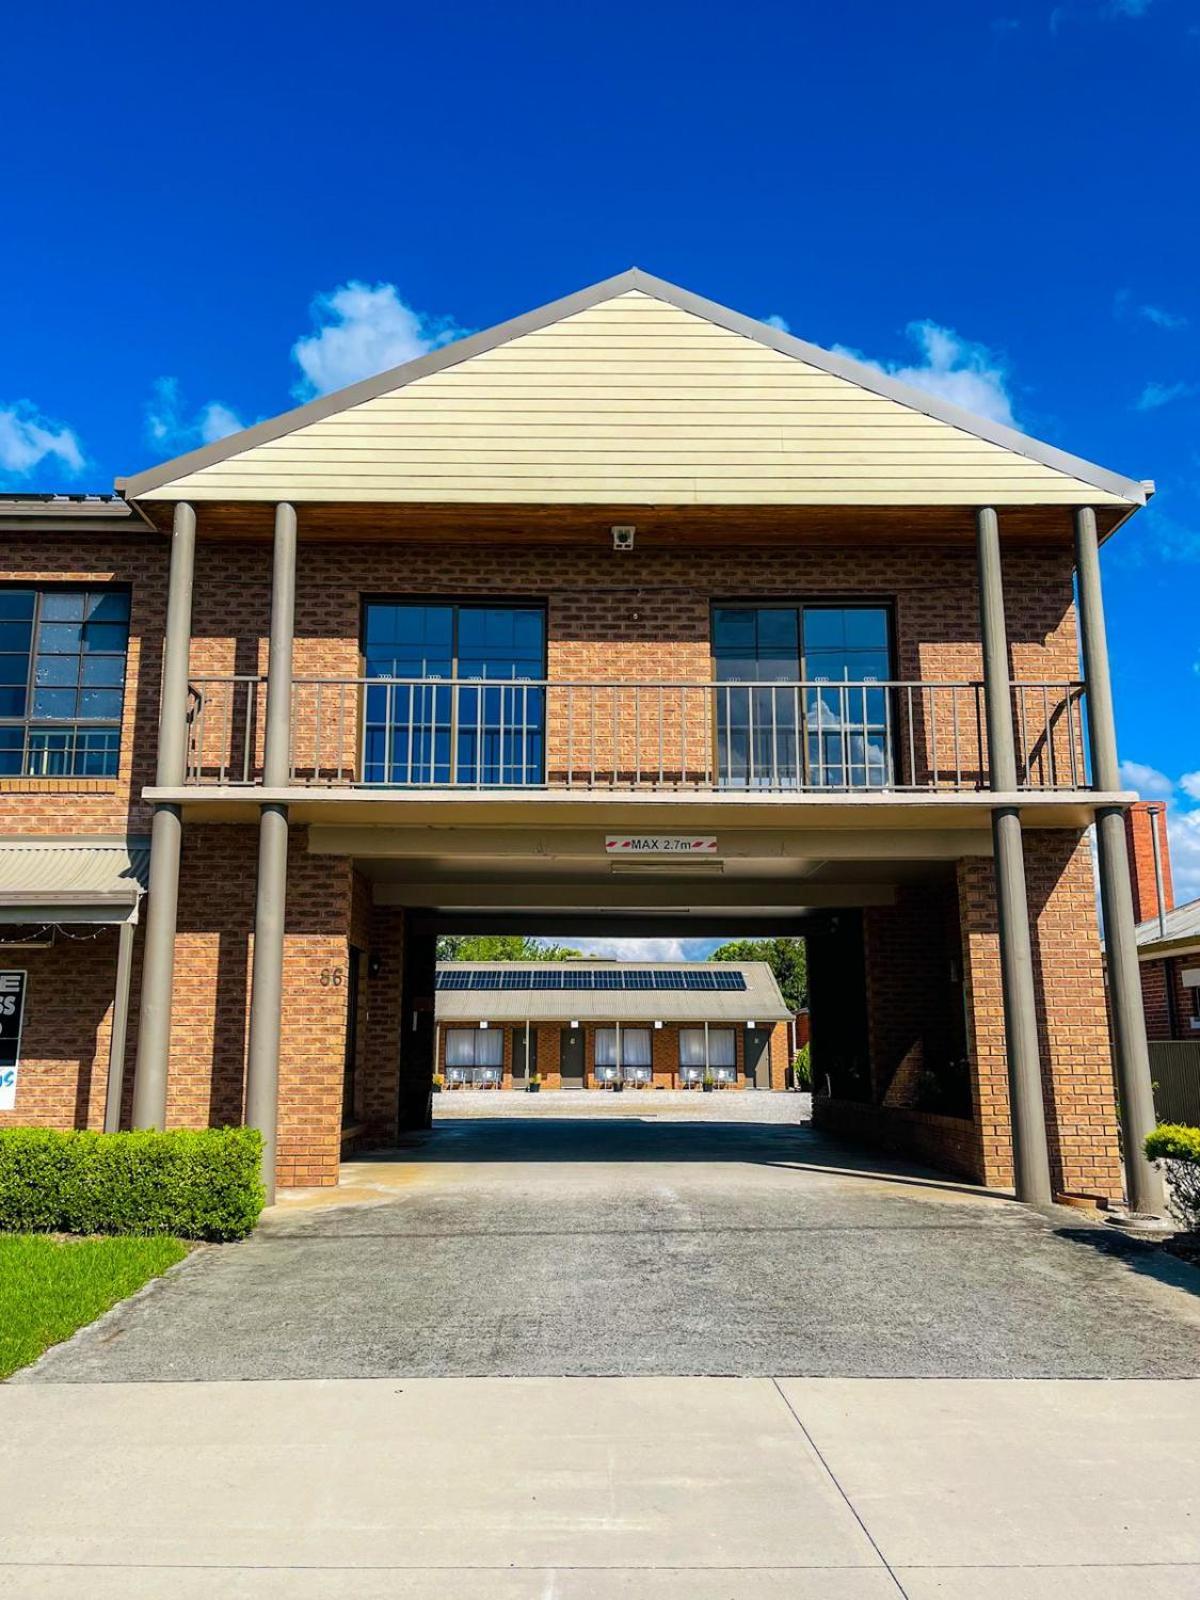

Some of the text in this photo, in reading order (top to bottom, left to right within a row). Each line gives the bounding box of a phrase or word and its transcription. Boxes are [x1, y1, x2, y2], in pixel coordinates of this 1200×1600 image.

[631, 839, 691, 850] MAX 2.7m
[320, 968, 342, 987] 86
